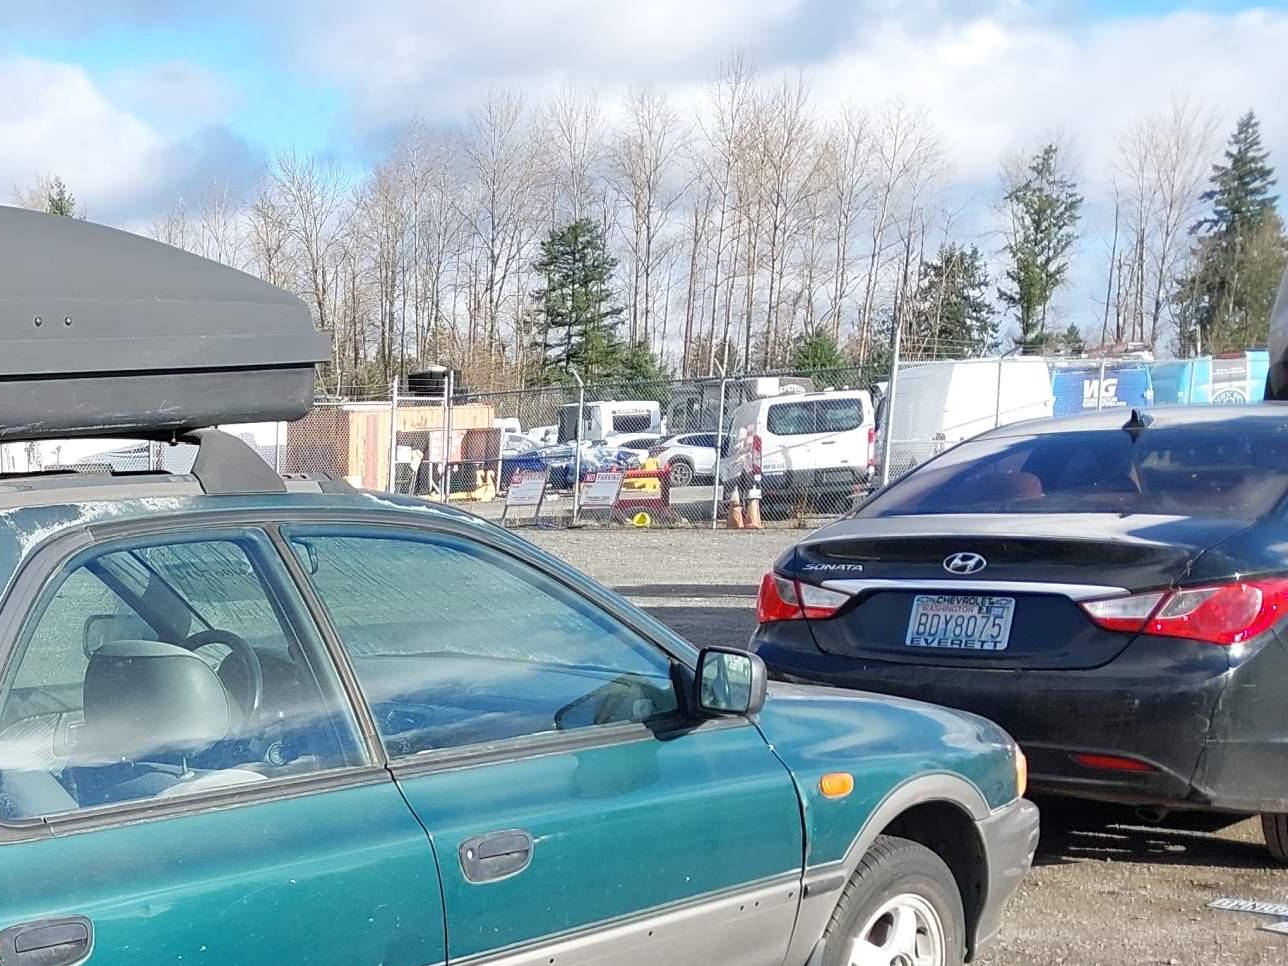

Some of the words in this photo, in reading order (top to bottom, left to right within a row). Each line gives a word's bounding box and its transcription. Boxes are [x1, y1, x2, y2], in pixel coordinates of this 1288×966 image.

[802, 563, 864, 572] SONATA
[935, 596, 994, 606] CHEVROLET
[921, 604, 974, 613] WASHINGTON
[917, 613, 1002, 639] BDY8075
[910, 637, 1003, 649] EVERETT
